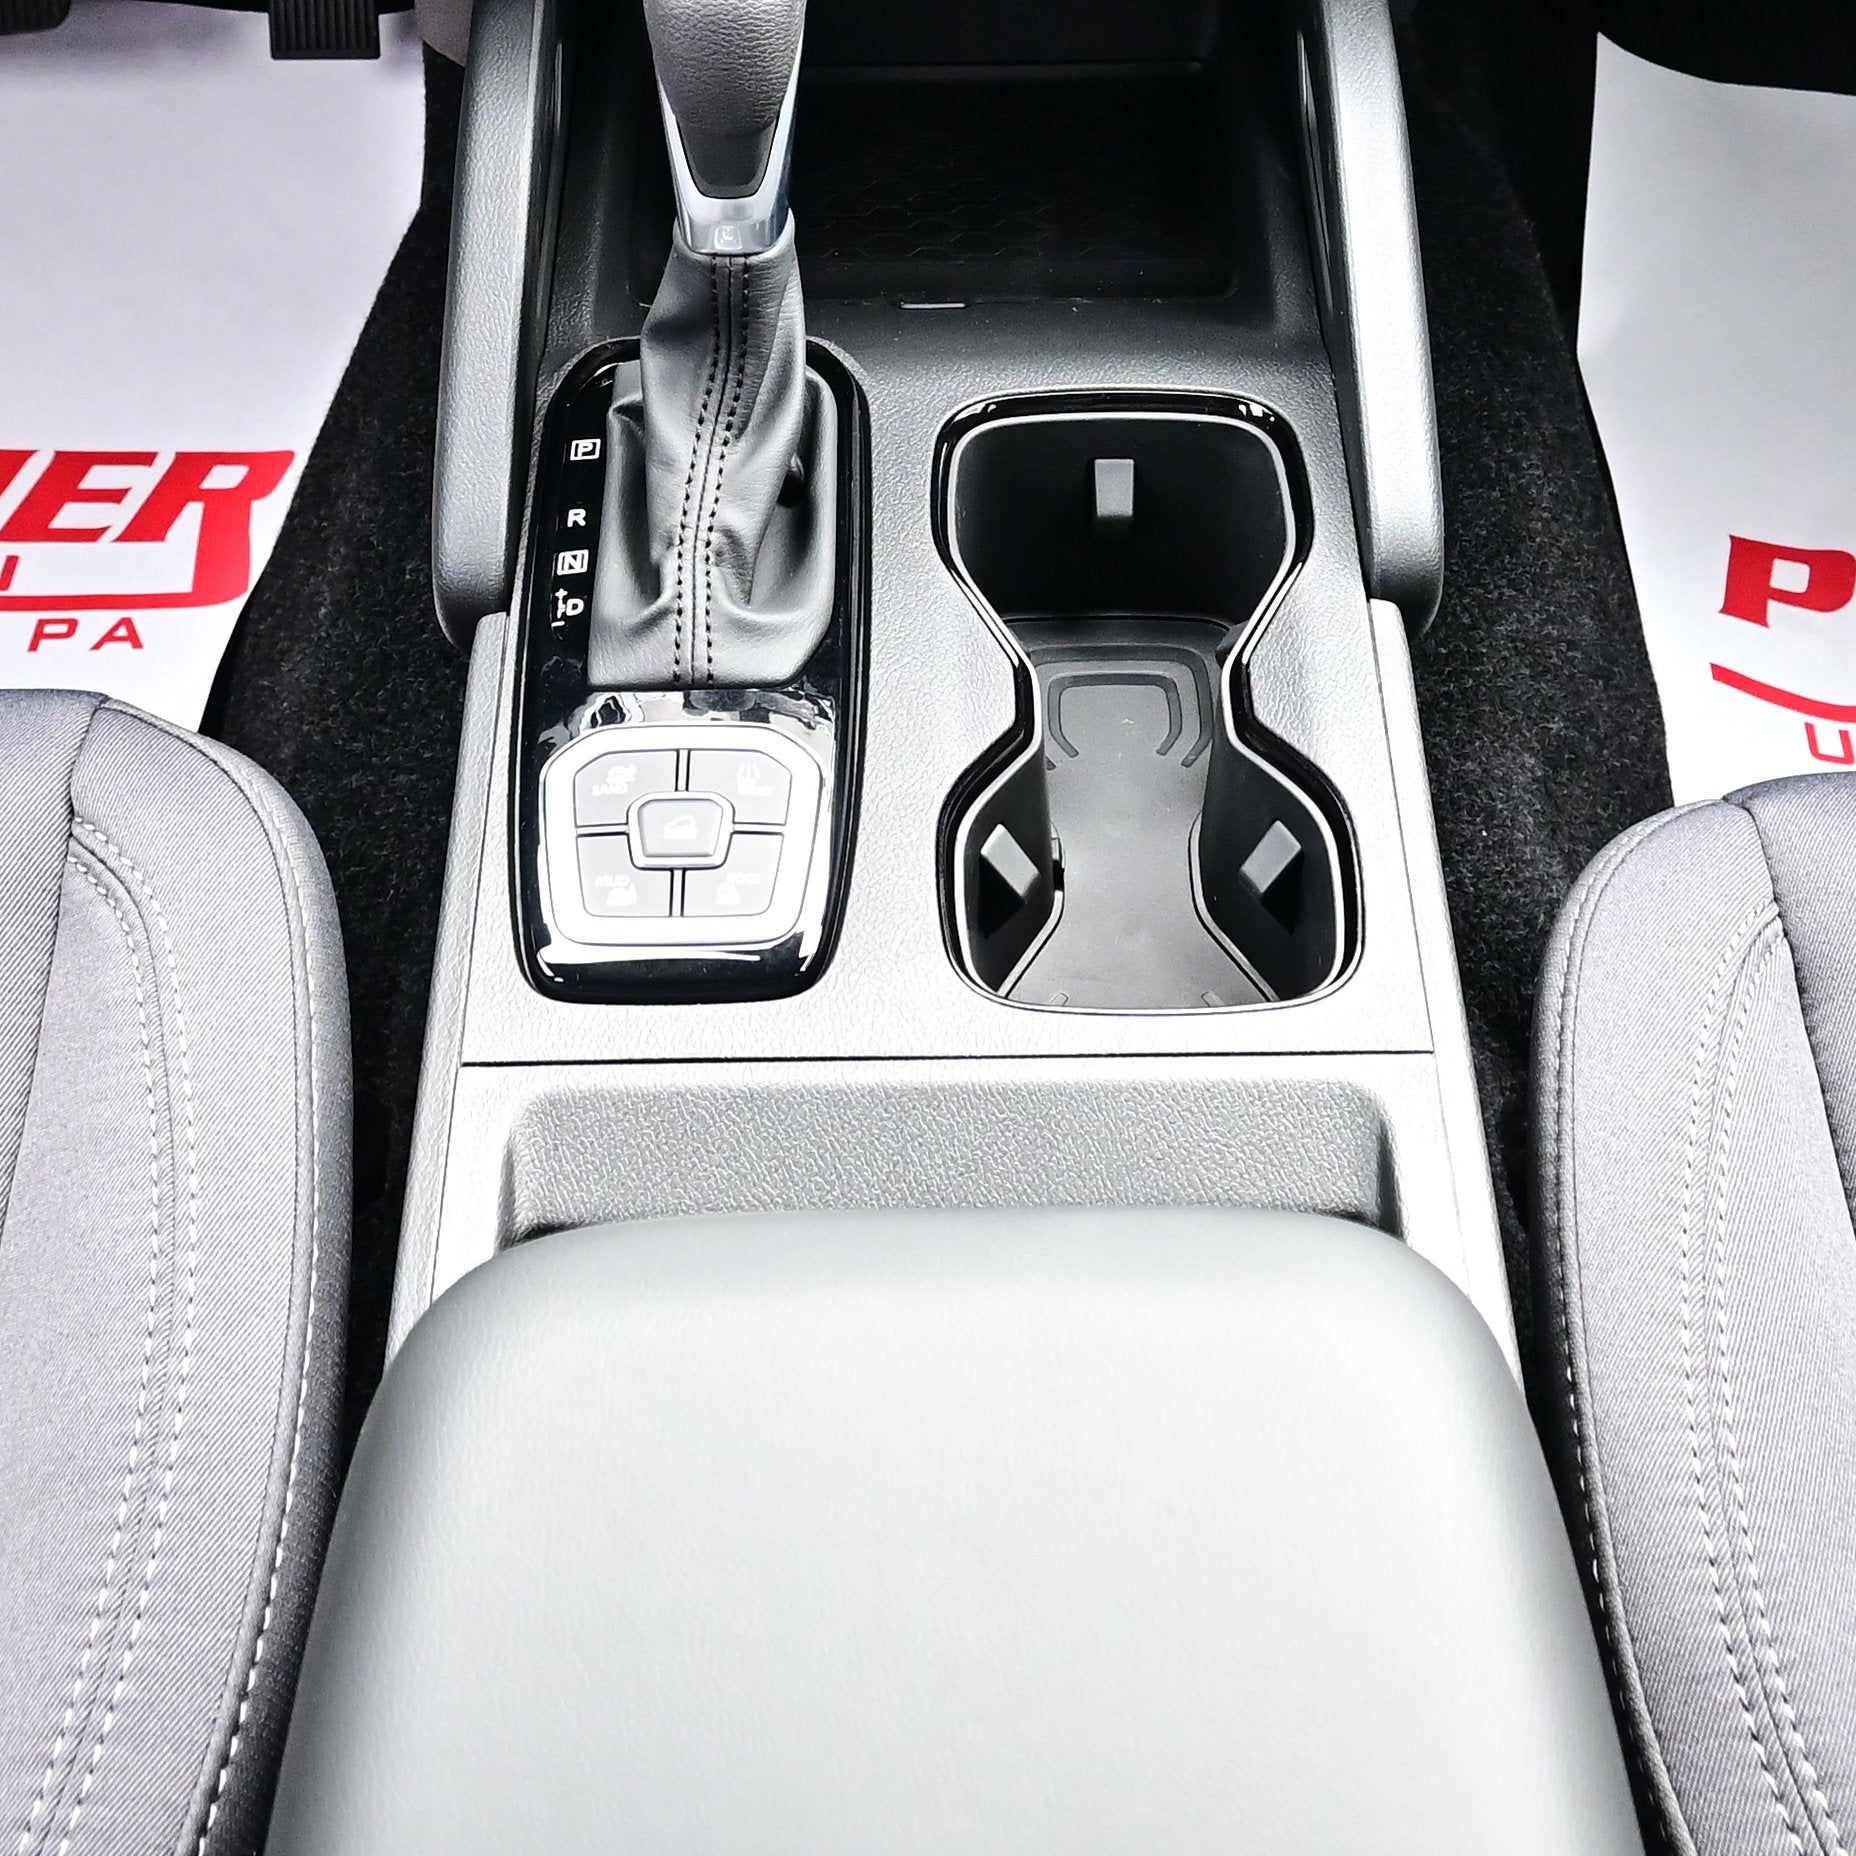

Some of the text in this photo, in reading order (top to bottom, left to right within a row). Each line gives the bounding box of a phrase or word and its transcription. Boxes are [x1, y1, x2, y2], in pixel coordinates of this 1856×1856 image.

[568, 508, 587, 527] R
[566, 598, 584, 616] D
[27, 616, 146, 652] PA
